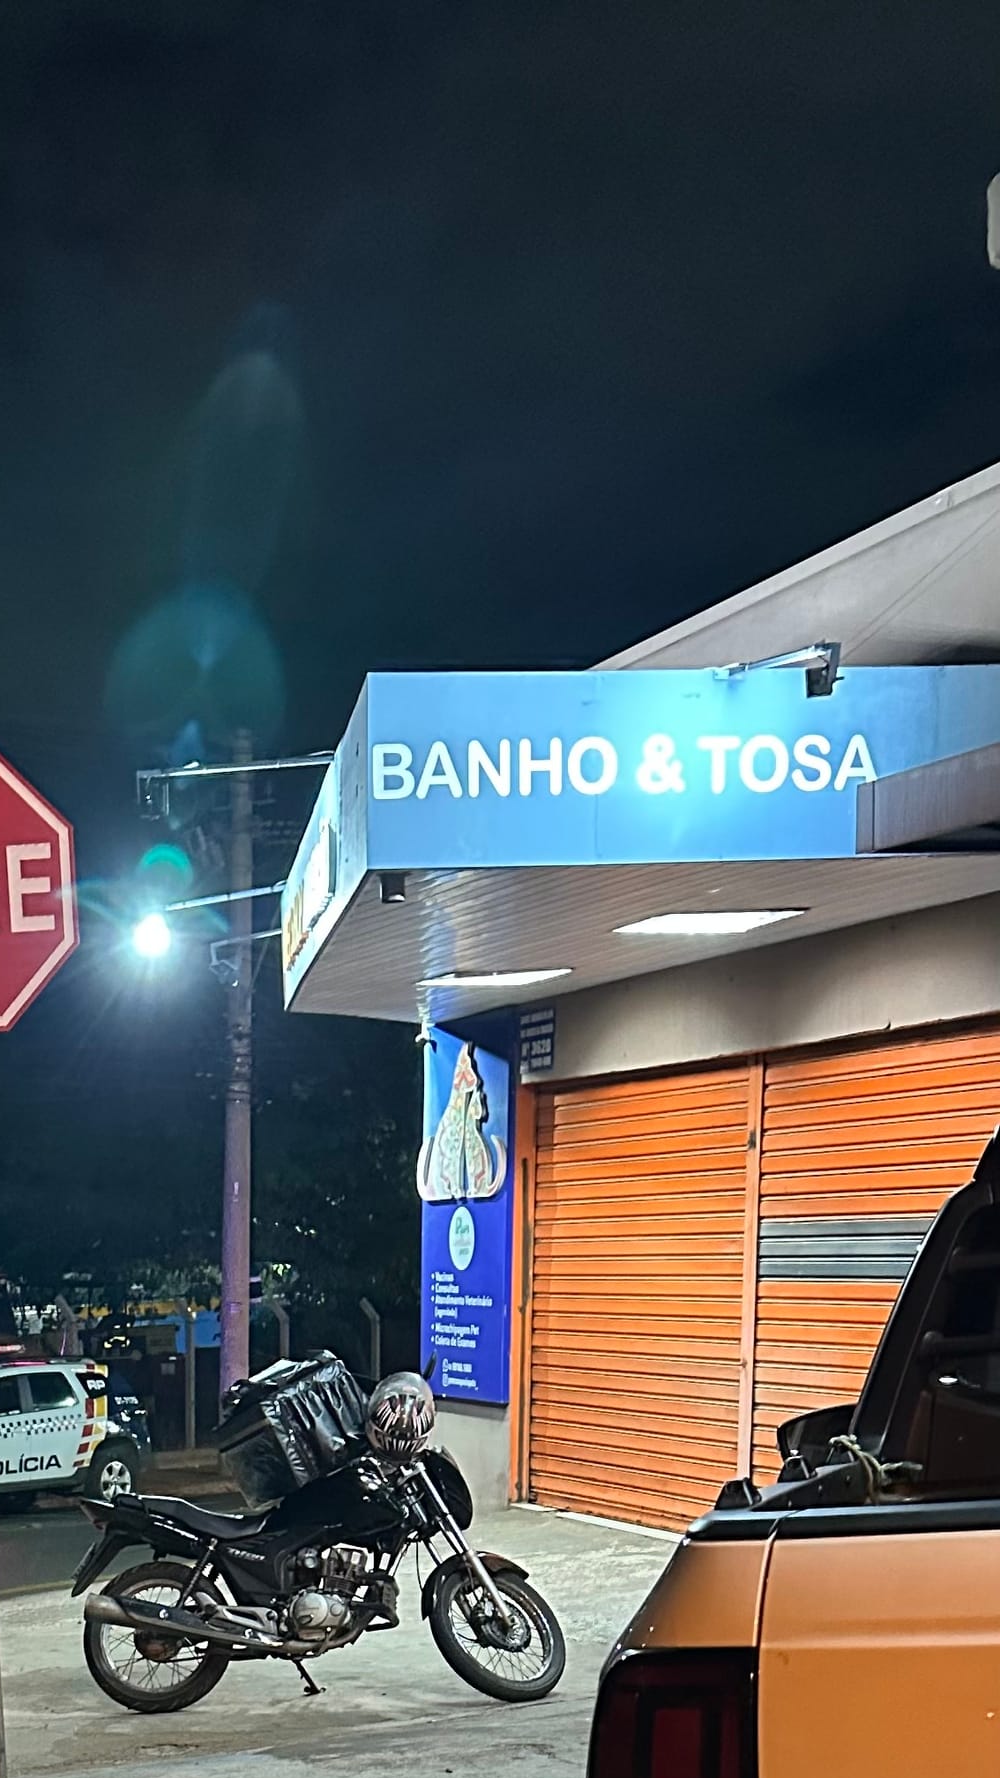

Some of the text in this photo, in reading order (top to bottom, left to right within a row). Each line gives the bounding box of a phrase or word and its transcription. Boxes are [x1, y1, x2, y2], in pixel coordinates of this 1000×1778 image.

[372, 733, 878, 799] BANHO & TOSA
[86, 1379, 106, 1390] RP
